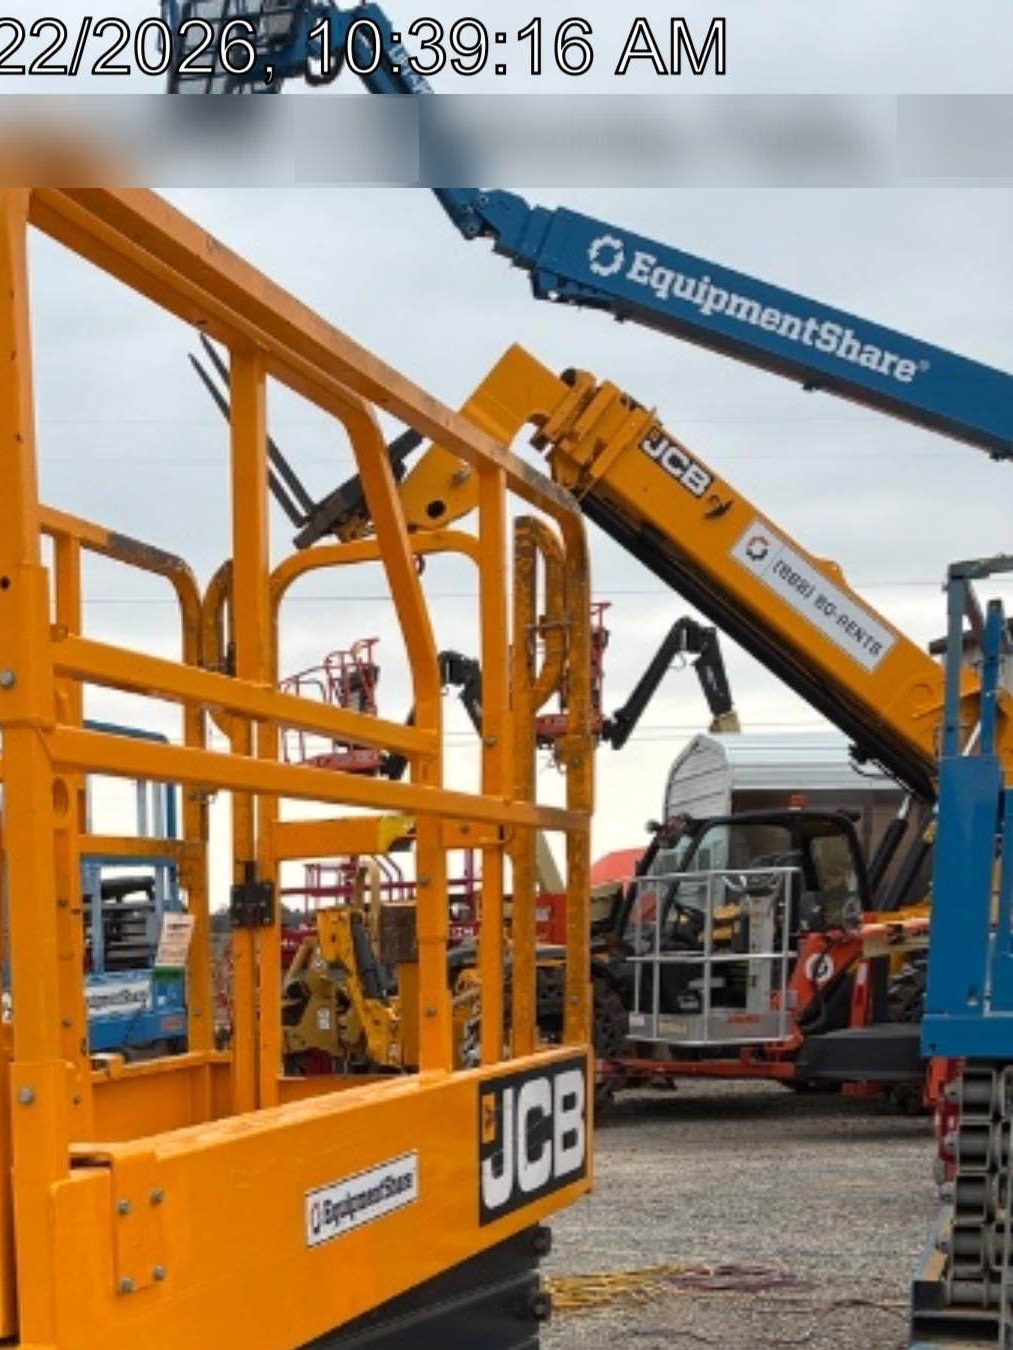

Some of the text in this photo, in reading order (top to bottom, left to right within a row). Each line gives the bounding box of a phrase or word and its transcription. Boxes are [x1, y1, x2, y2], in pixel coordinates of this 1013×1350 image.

[625, 250, 917, 383] EquipmentShare
[641, 437, 714, 498] JCB
[481, 1070, 586, 1210] JCB
